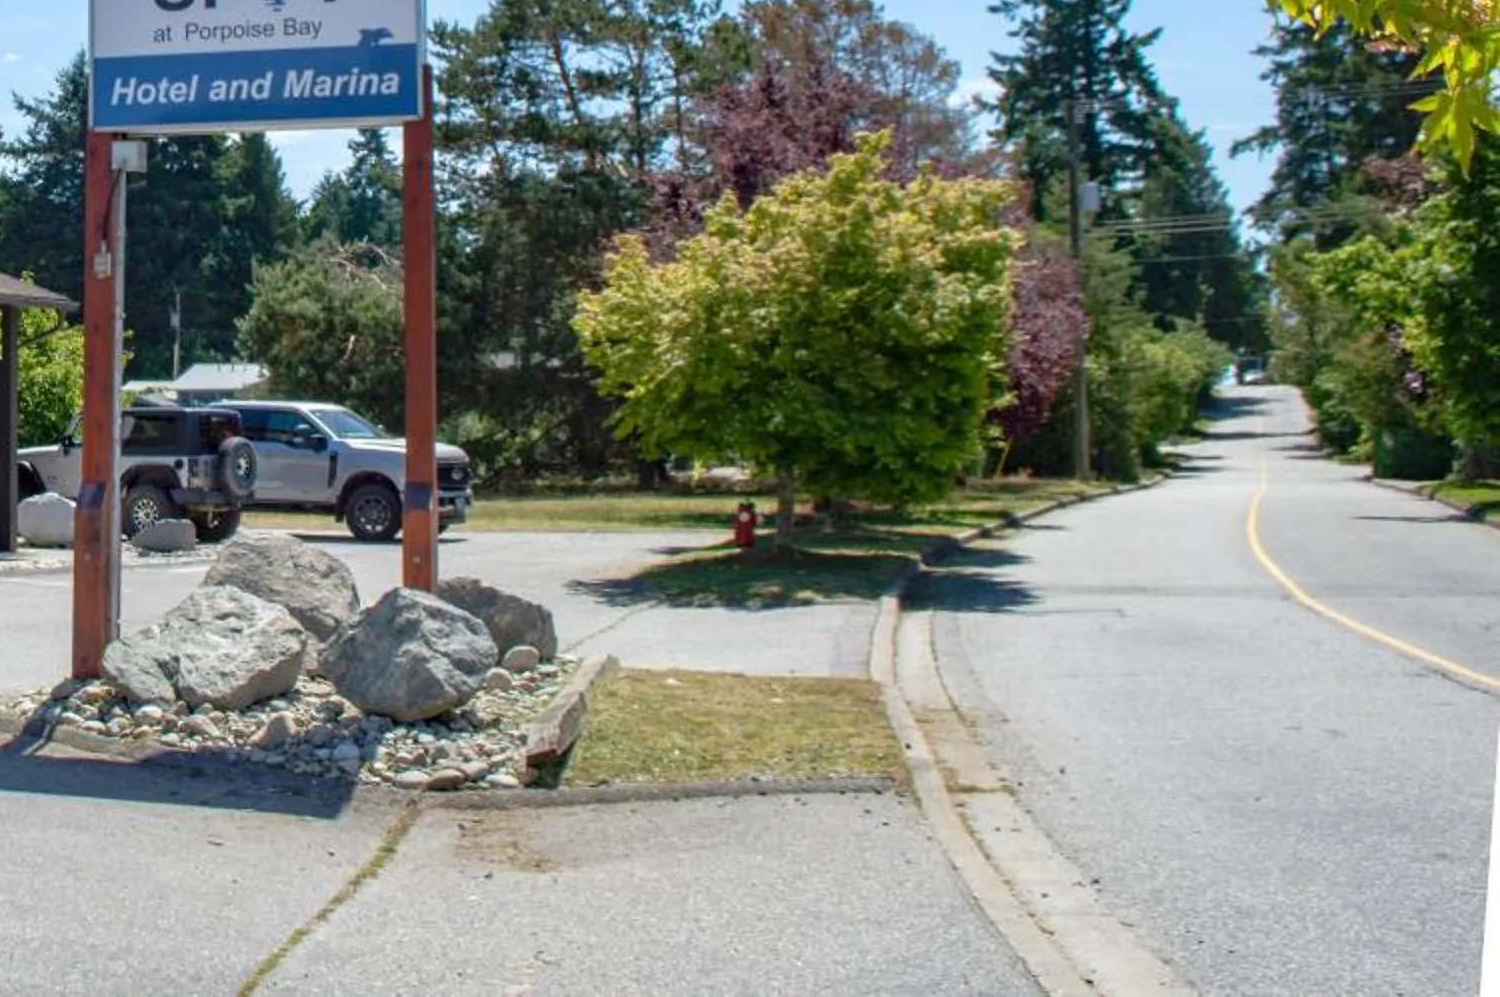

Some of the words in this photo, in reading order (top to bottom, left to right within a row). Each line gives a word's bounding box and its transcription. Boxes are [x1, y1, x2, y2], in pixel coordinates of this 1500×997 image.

[153, 26, 172, 43] at
[185, 20, 275, 43] Porpoise
[283, 17, 322, 39] Bay
[111, 75, 198, 105] Hotel
[209, 70, 274, 101] and
[283, 67, 400, 99] Marina
